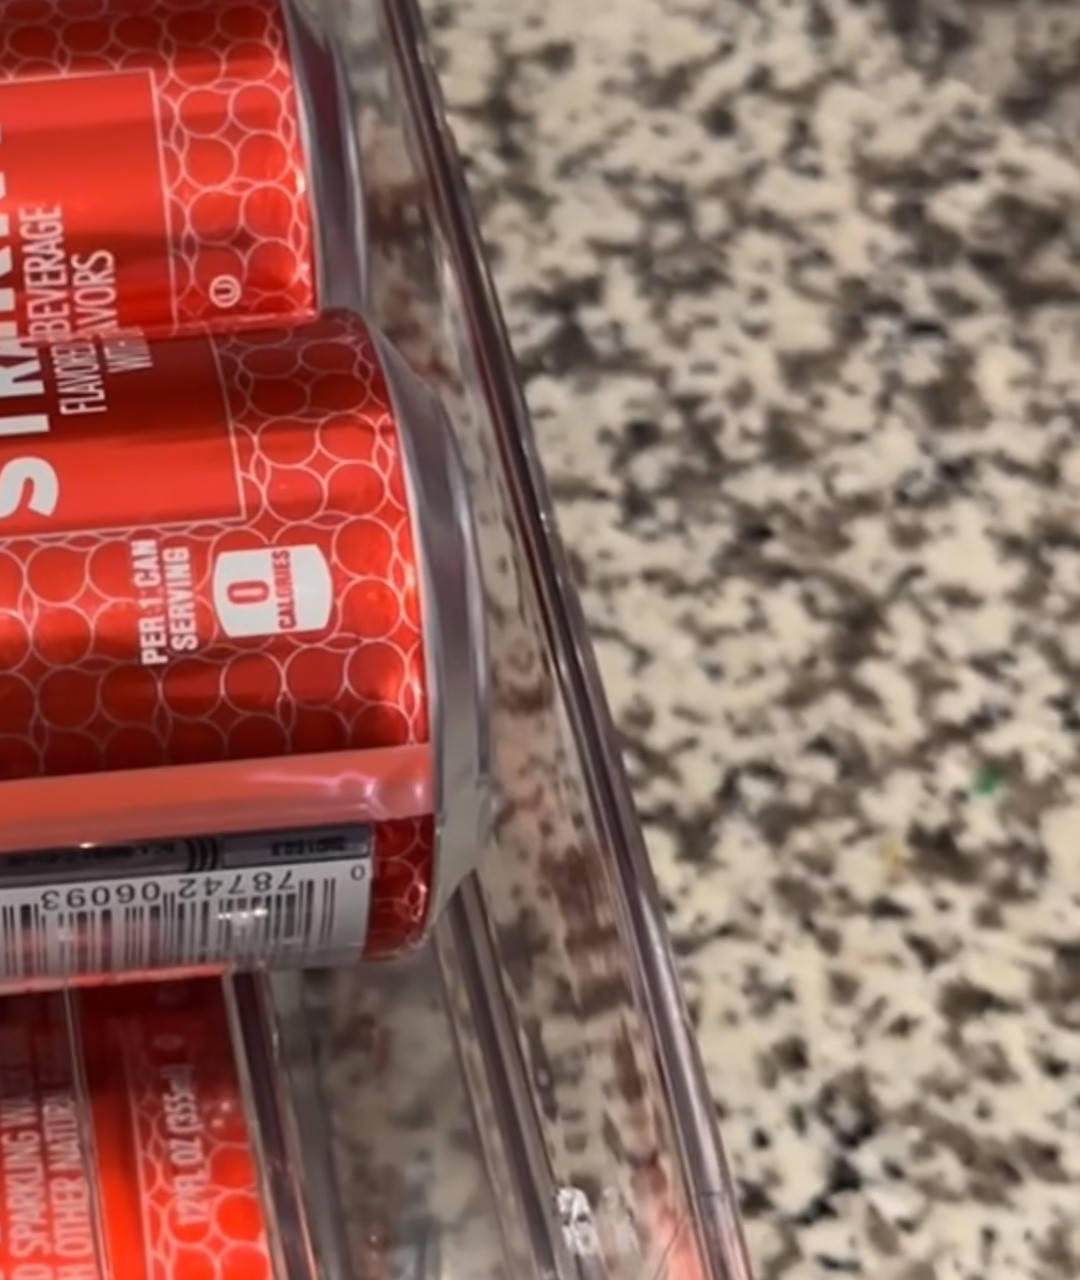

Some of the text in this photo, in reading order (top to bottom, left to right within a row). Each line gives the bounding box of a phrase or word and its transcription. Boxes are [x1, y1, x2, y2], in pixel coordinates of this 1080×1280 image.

[18, 204, 71, 337] BEVERAGE
[130, 538, 168, 666] PER 1 CAN
[162, 546, 199, 652] SERVING
[226, 579, 270, 606] 0
[272, 549, 297, 631] CALORIES
[39, 880, 162, 912] 06093
[177, 869, 296, 899] 78742
[350, 864, 366, 881] 0
[1, 1131, 50, 1258] SPARKLING
[50, 1176, 95, 1258] OTHER
